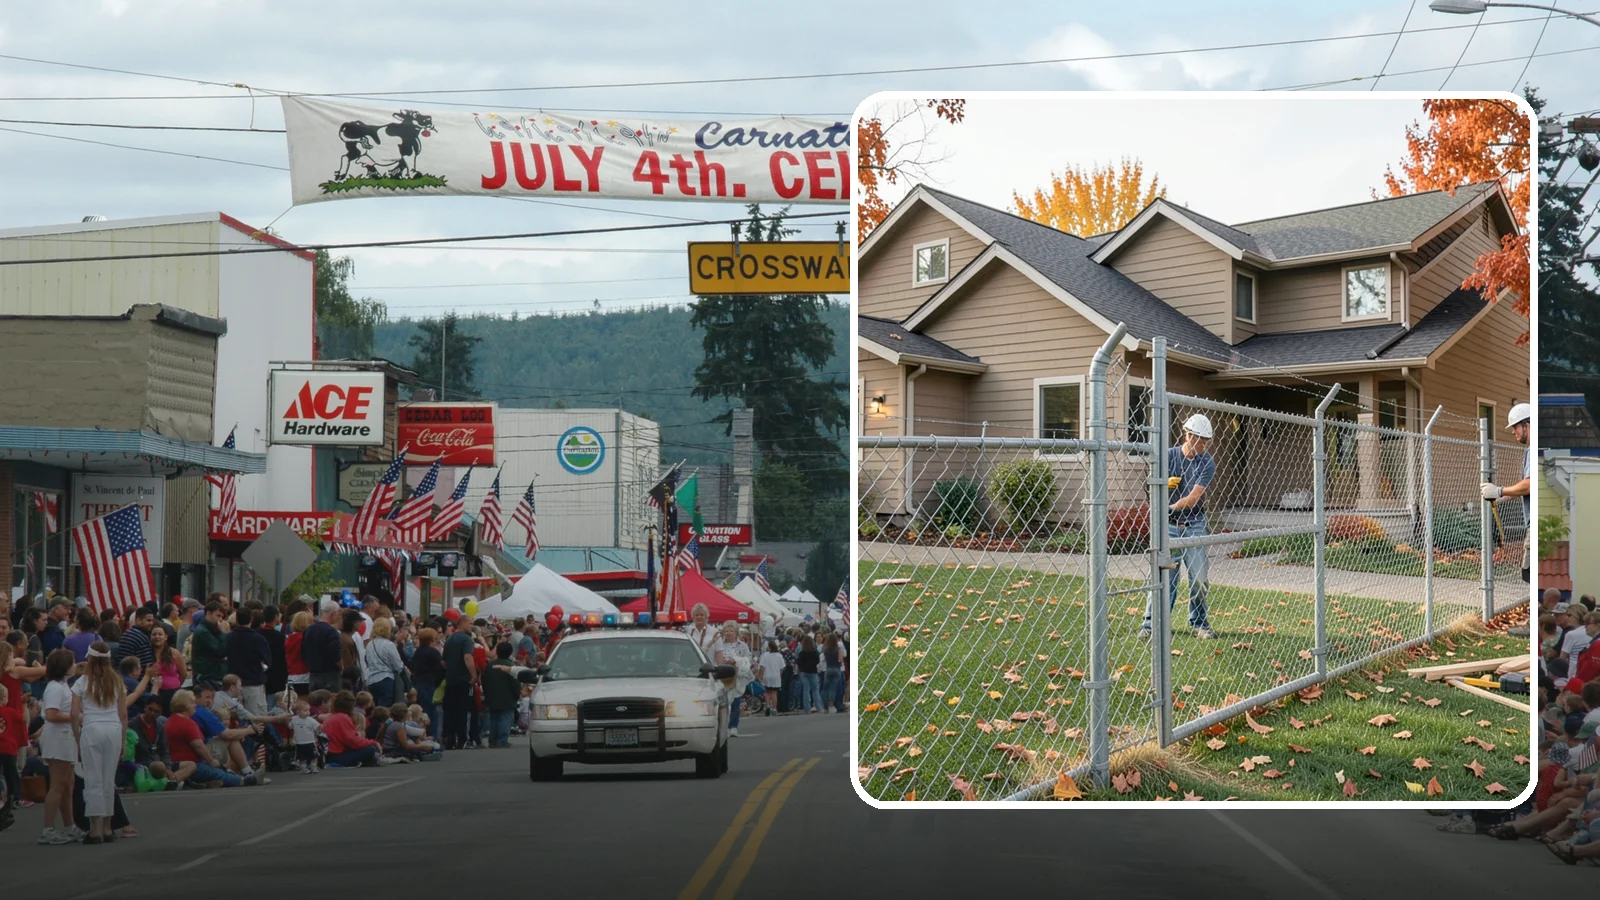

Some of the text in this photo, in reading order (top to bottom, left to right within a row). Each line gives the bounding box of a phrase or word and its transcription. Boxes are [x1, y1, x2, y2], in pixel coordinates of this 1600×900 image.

[481, 141, 605, 192] JULY
[632, 150, 746, 197] 4th.
[697, 254, 850, 280] CROSSWA
[282, 380, 373, 420] ACE
[405, 409, 453, 422] CEDAR
[283, 421, 371, 436] Hardware
[416, 428, 477, 447] Coca-Cola
[95, 485, 124, 495] Vincent
[126, 486, 136, 495] de
[137, 485, 155, 495] Paul
[688, 526, 741, 535] CRNATION
[699, 535, 730, 543] GLASS
